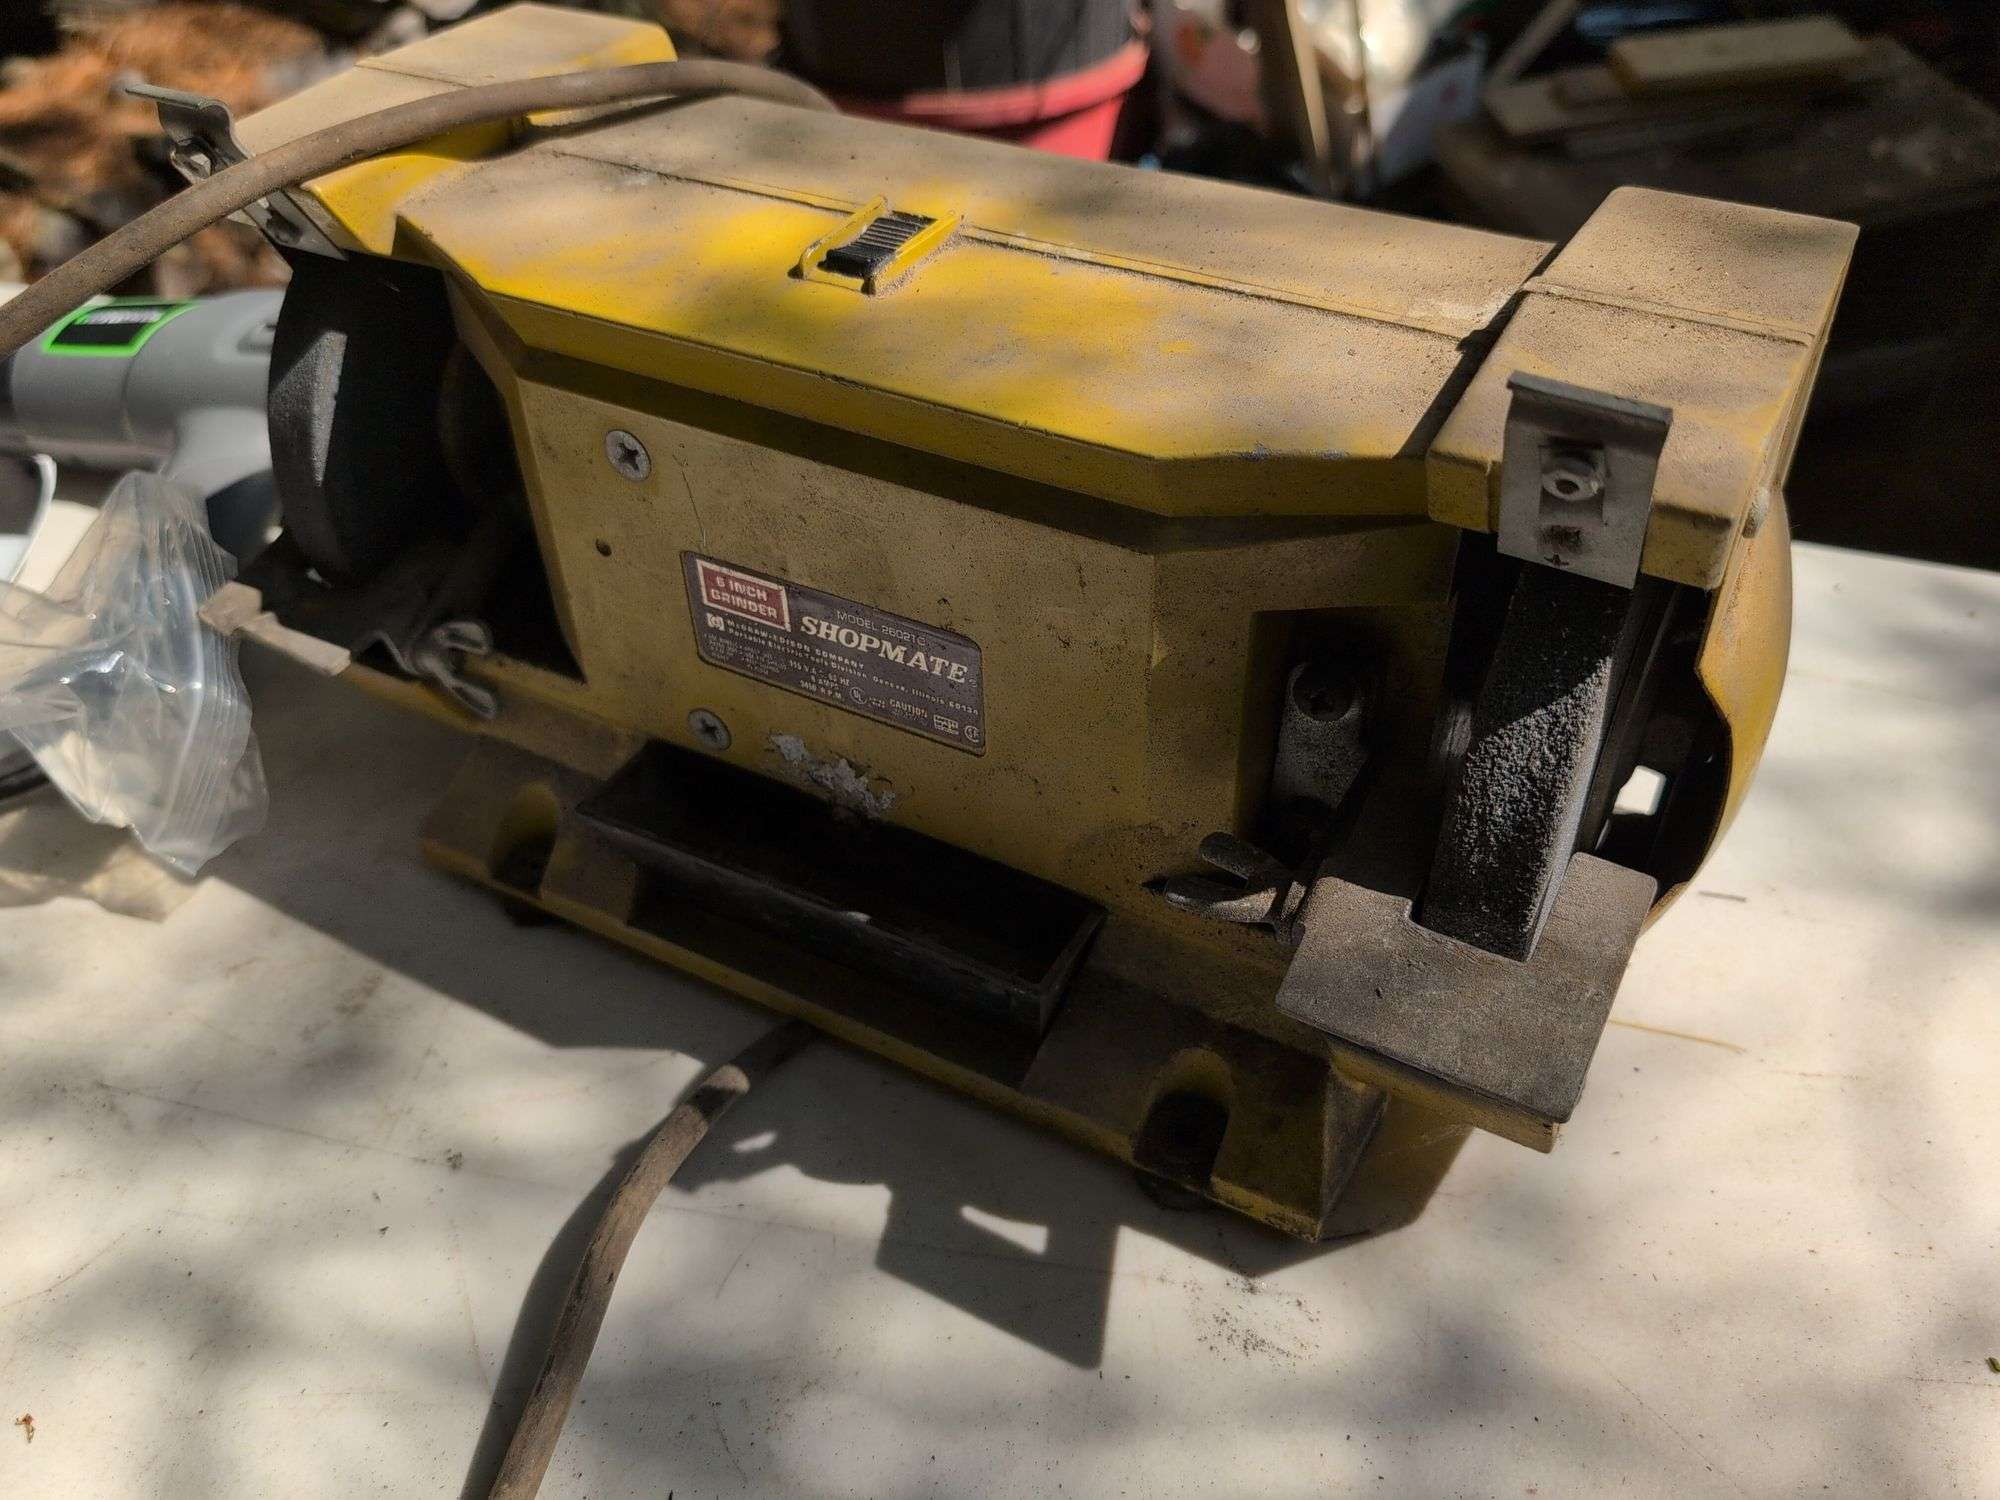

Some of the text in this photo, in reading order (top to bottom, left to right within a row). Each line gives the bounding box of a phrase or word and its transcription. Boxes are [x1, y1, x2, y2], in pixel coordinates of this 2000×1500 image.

[711, 588, 778, 619] GRINDER
[728, 580, 769, 602] INCH
[836, 610, 878, 631] MODEL
[800, 616, 968, 683] SHOPMATE
